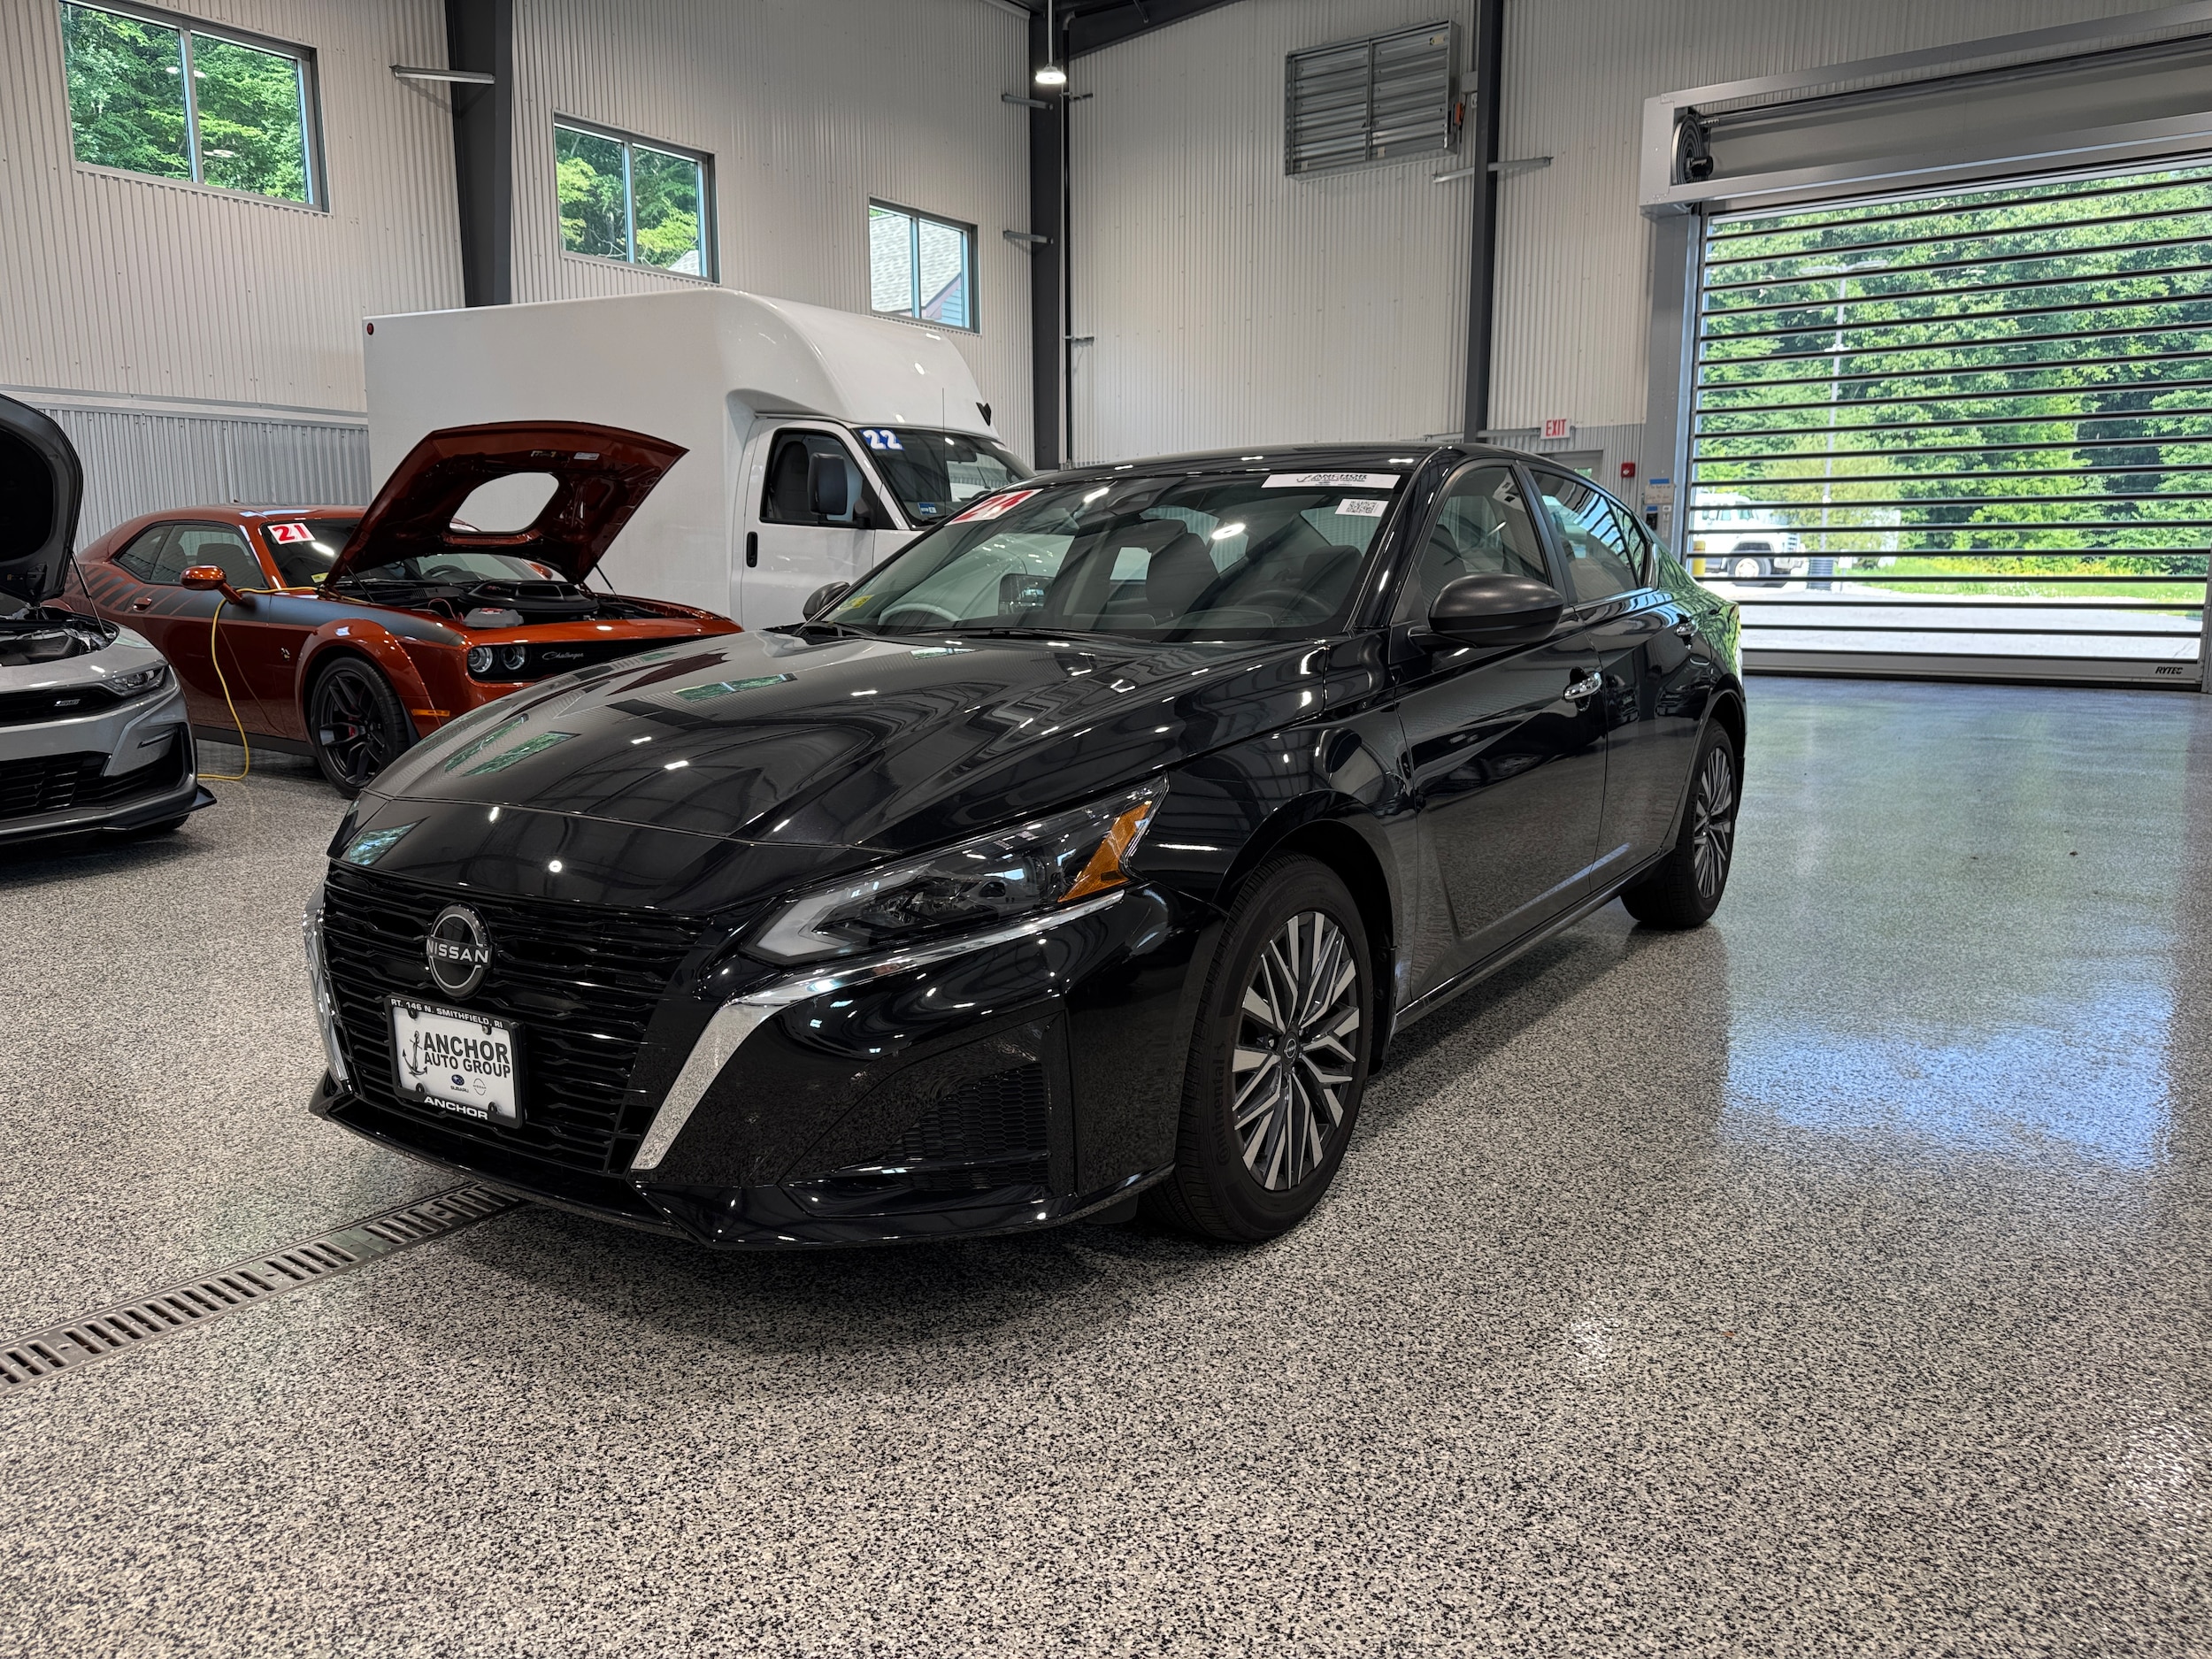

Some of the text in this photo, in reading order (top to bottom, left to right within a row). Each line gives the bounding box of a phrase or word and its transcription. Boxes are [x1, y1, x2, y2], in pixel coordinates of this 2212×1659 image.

[1546, 419, 1567, 437] EXIT
[863, 430, 903, 449] 22
[273, 525, 309, 541] 21
[2154, 666, 2184, 675] RYTEC
[426, 939, 488, 963] NISSAN
[406, 1002, 422, 1010] 146
[424, 1032, 511, 1064] ANCHOR
[425, 1052, 511, 1078] AUTO GROUP
[424, 1096, 488, 1121] ANCHOR
[1212, 1059, 1231, 1167] Continental
